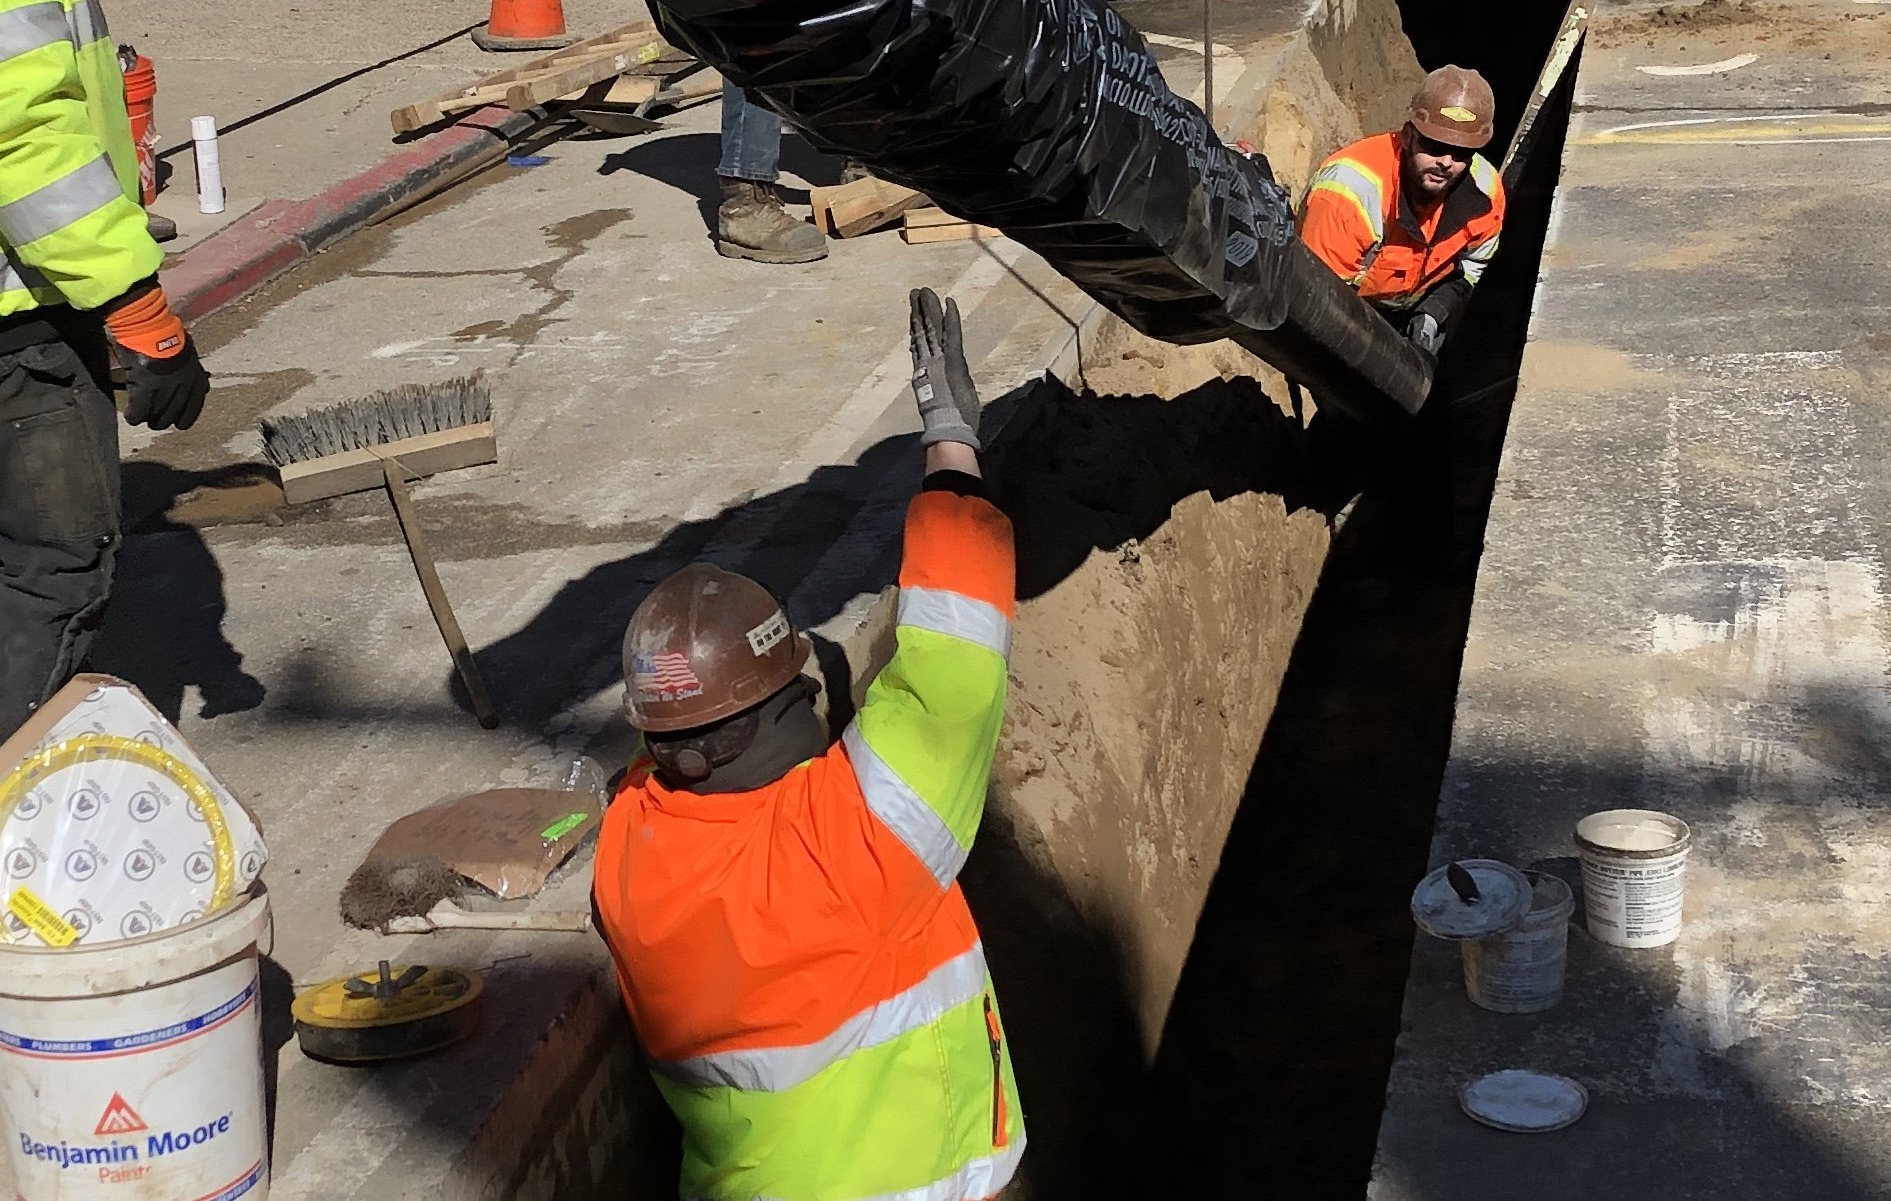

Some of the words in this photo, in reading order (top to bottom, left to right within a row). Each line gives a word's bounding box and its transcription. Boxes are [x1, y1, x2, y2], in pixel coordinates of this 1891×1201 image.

[31, 1039, 92, 1051] PLUMBERS
[113, 1024, 188, 1048] GARDENERS
[20, 1131, 139, 1169] Benjamin
